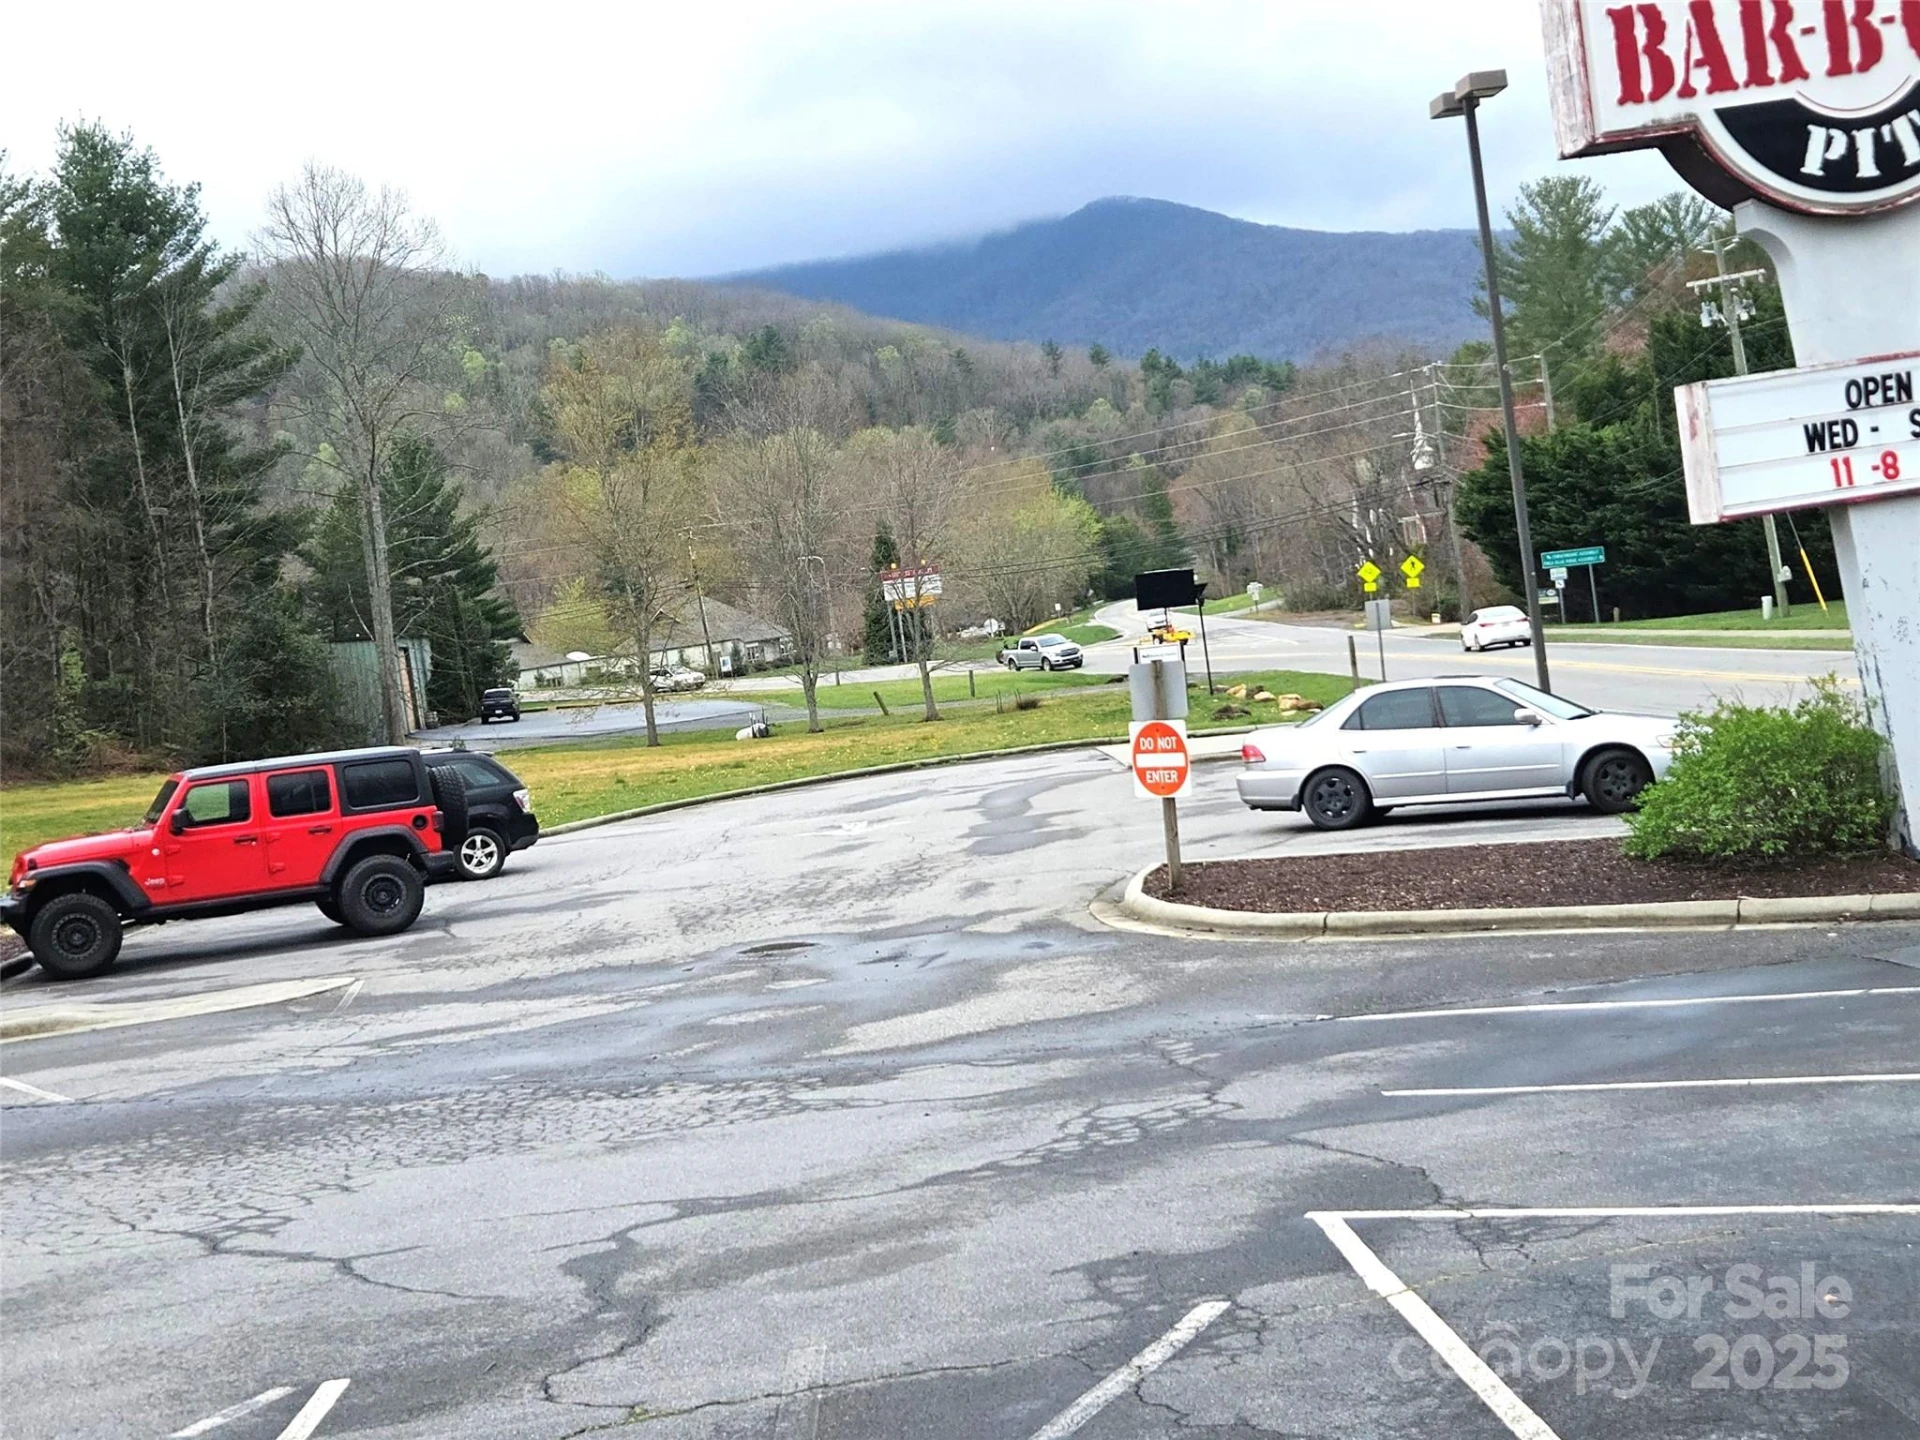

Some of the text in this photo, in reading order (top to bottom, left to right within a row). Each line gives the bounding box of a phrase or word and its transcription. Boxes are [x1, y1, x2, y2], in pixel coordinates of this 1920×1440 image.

[1800, 109, 1920, 178] PIT
[1845, 371, 1913, 409] OPEN
[1803, 418, 1858, 453] WED
[1830, 456, 1854, 487] 11
[1140, 736, 1177, 750] DO NOT
[1146, 770, 1178, 783] ENTER
